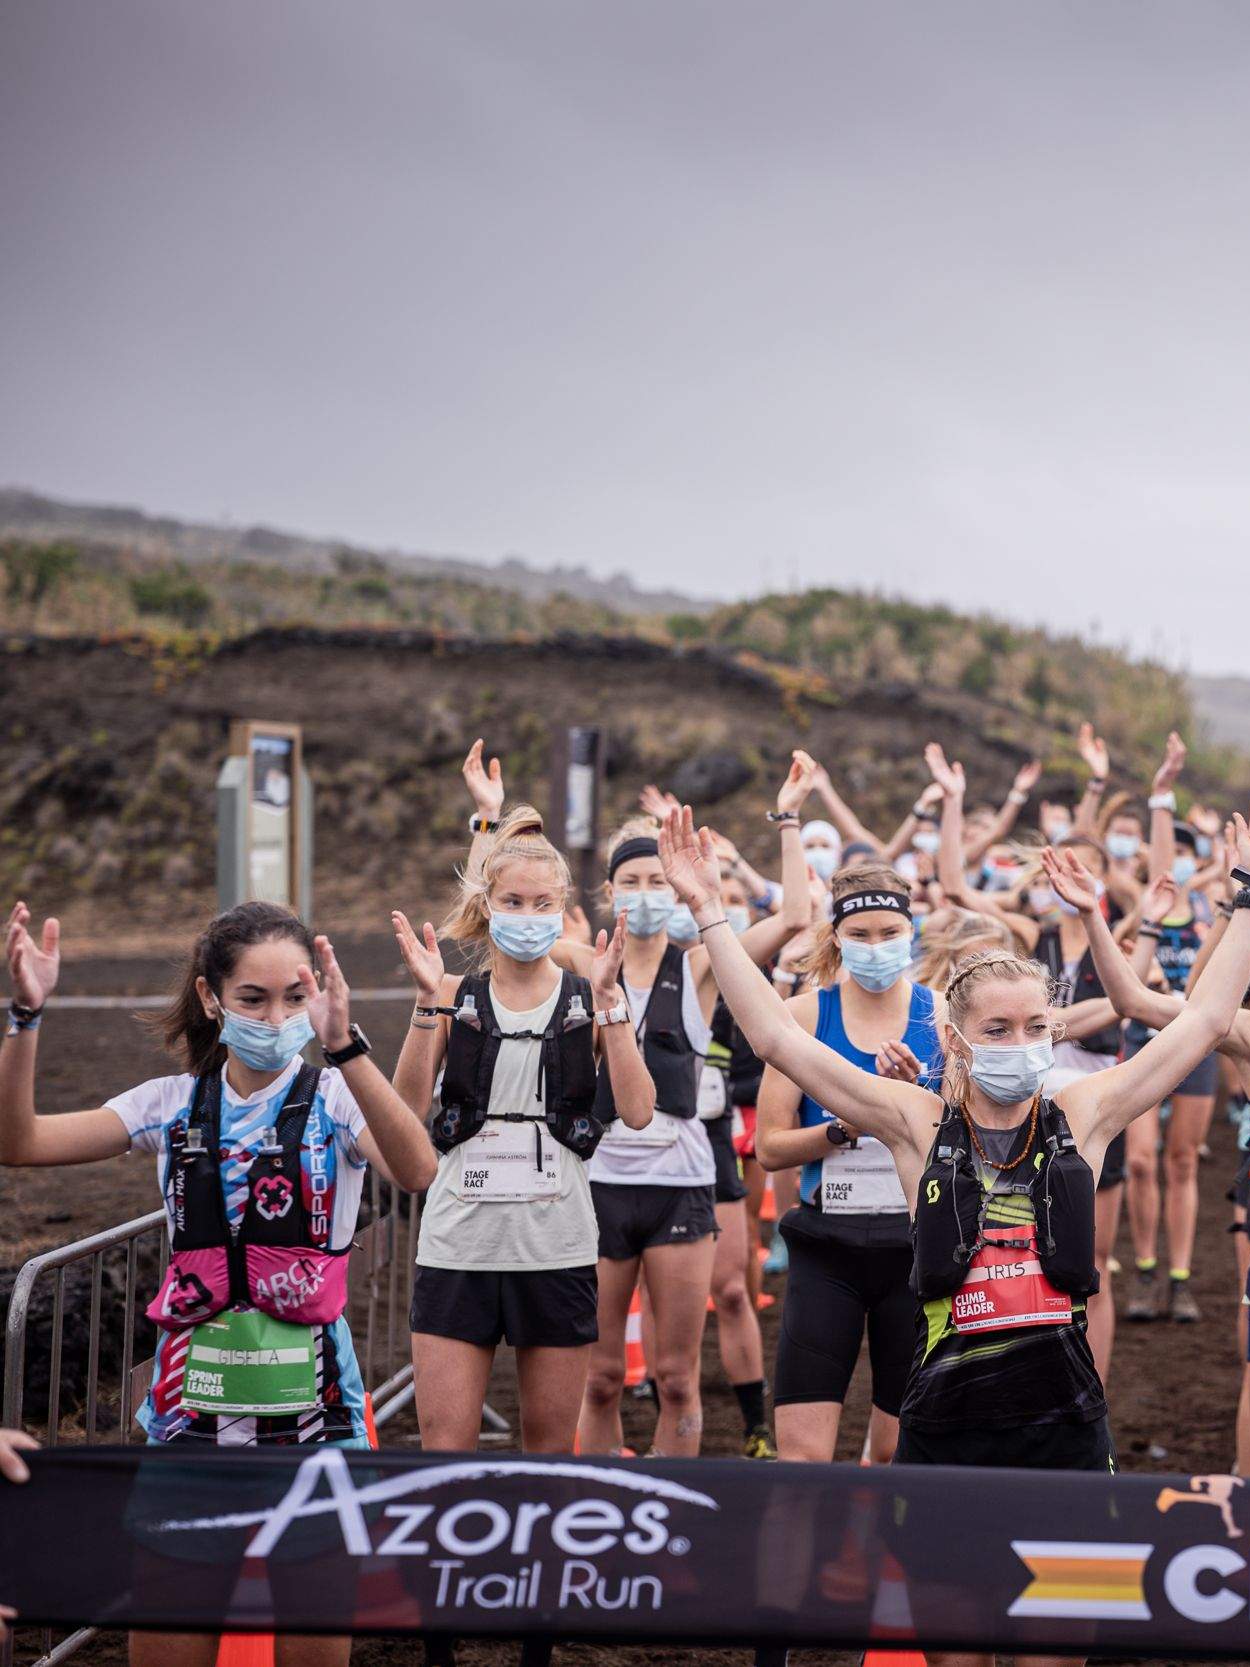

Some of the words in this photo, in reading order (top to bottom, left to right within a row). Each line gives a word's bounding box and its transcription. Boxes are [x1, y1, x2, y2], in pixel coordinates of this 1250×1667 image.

[842, 895, 899, 912] SILVA
[464, 1170, 489, 1179] STAGE
[546, 1171, 557, 1179] 86
[463, 1180, 485, 1188] RACE
[826, 1183, 853, 1192] STAGE
[825, 1192, 848, 1200] RACE
[984, 1262, 1026, 1281] IRIS
[955, 1290, 987, 1307] CLIMB
[956, 1301, 996, 1318] LEADER
[187, 1368, 224, 1385] SPRINT
[186, 1381, 225, 1398] LEADER
[429, 1558, 542, 1609] Trail
[558, 1561, 662, 1610] Run
